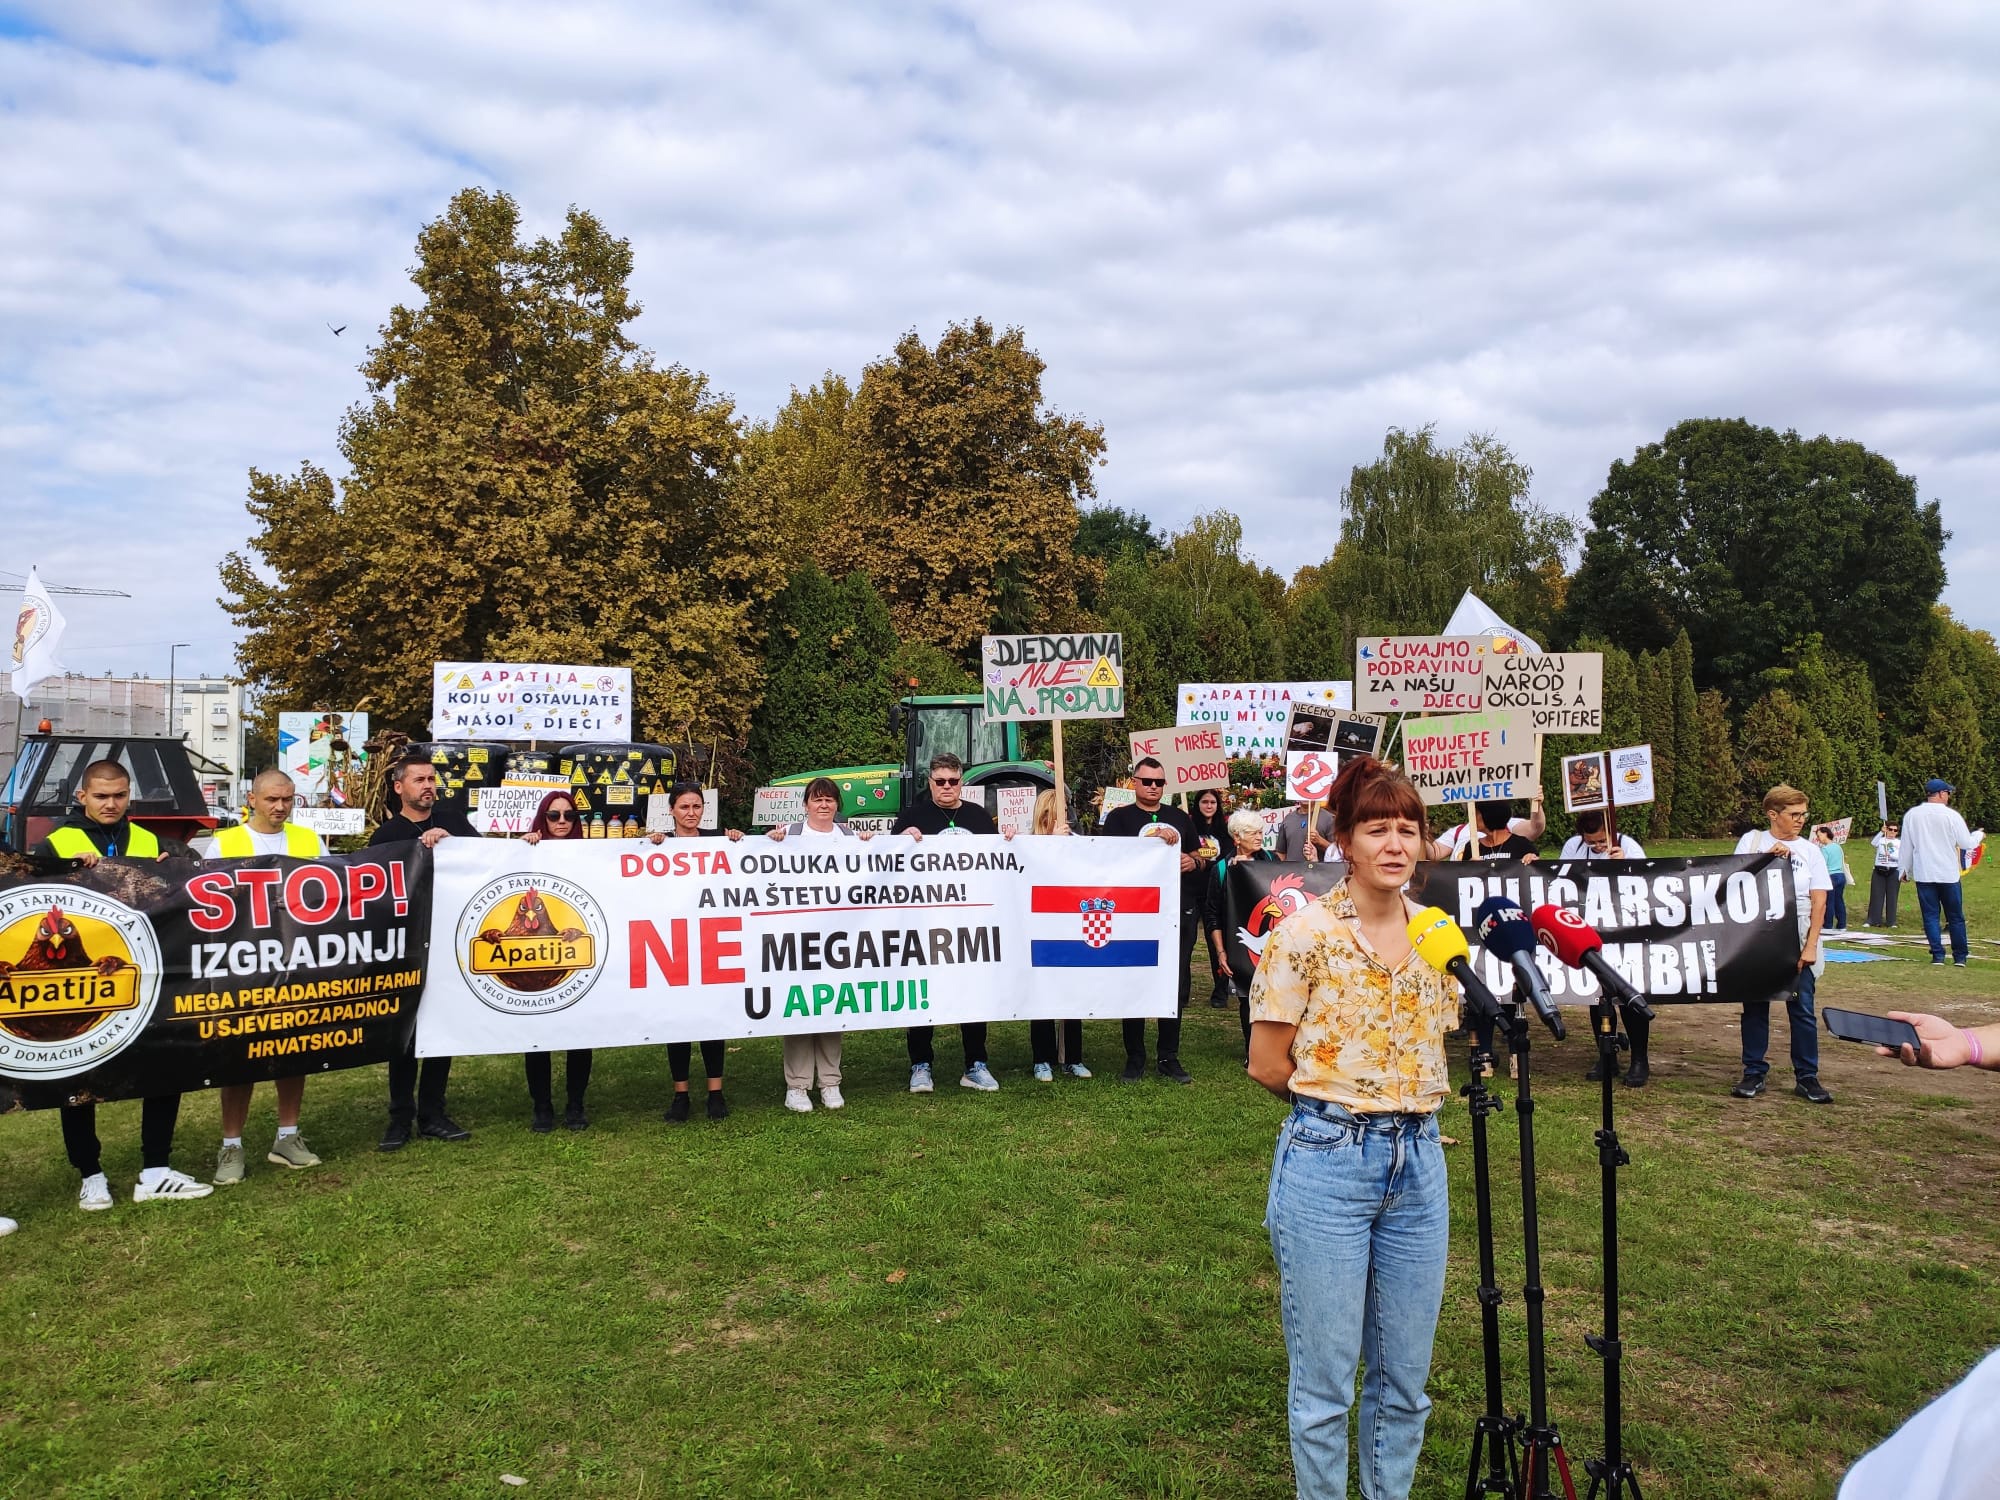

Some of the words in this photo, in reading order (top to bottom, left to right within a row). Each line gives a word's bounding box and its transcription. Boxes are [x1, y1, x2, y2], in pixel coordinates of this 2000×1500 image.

[990, 634, 1122, 667] DJEDOVINA
[1379, 637, 1470, 659] ČUVAJMO
[1017, 660, 1093, 689] NIJE
[1367, 659, 1482, 677] PODRAVINU
[1504, 655, 1565, 673] ČUVAJ
[481, 671, 578, 685] APATIJA
[1370, 679, 1395, 693] ZA
[1404, 673, 1455, 693] NAŠU
[1485, 673, 1565, 692] NAROD
[1578, 675, 1583, 691] I
[448, 692, 490, 705] KOJU
[497, 692, 514, 704] VI
[522, 692, 620, 706] OSTAVLJATE
[986, 686, 1028, 717] NA
[1036, 685, 1124, 714] PRODAJU
[1422, 693, 1482, 709] DJECU
[1572, 694, 1586, 707] A
[457, 712, 514, 727] NAŠOJ
[544, 717, 602, 730] DJECI
[1190, 710, 1229, 722] KOJU
[1237, 710, 1257, 722] MI
[1265, 710, 1286, 722] VO
[1349, 713, 1374, 725] OVO
[1532, 709, 1600, 728] OFITERE
[1133, 739, 1161, 756] NE
[1174, 730, 1222, 753] MIRIŠE
[1224, 736, 1284, 748] BRANI
[1407, 731, 1490, 755] KUPUJETE
[1501, 729, 1506, 745] I
[1407, 750, 1486, 771] TRUJETE
[1176, 761, 1228, 784] DOBRO
[1411, 768, 1471, 788] PRLJAVI
[1478, 763, 1534, 782] PROFIT
[480, 789, 493, 800] MI
[498, 789, 543, 801] HODAMO
[998, 788, 1035, 798] TRUJETE
[1441, 782, 1514, 803] SNUJETE
[484, 800, 538, 810] UZDIGNUTE
[487, 809, 523, 819] GLAVE
[770, 801, 798, 810] UZETI
[489, 818, 501, 832] A
[505, 818, 521, 832] VI
[849, 819, 883, 831] DRUGE
[620, 850, 732, 878] DOSTA
[740, 853, 839, 874] ODLUKA
[845, 853, 861, 874] U
[867, 853, 905, 873] IME
[910, 852, 1025, 874] GRAĐANA,
[21, 895, 75, 908] FARMI
[185, 860, 409, 933] STOP!
[473, 884, 504, 913] STOP
[508, 878, 547, 890] FARMI
[551, 880, 590, 911] PILIĆA
[699, 887, 716, 908] A
[723, 886, 760, 907] NA
[765, 881, 842, 906] ŠTETU
[847, 883, 967, 904] GRAĐANA!
[191, 927, 407, 980] IZGRADNJI
[490, 942, 577, 967] Apatija
[628, 916, 746, 989] NE
[760, 925, 1002, 973] MEGAFARMI
[0, 975, 116, 1010] Apatija
[174, 990, 235, 1014] MEGA
[238, 976, 372, 1008] PERADARSKIH
[374, 968, 422, 990] FARMI
[481, 981, 505, 1001] SELO
[506, 994, 556, 1008] DOMAĆIH
[558, 979, 585, 1000] KOKA
[744, 986, 772, 1020] U
[783, 978, 930, 1019] APATIJI!
[199, 1021, 214, 1039] U
[217, 997, 401, 1037] SJEVEROZAPADNOJ
[14, 1046, 84, 1063] DOMAĆIH
[89, 1024, 125, 1051] KOKA
[247, 1028, 364, 1060] HRVATSKOJ!
